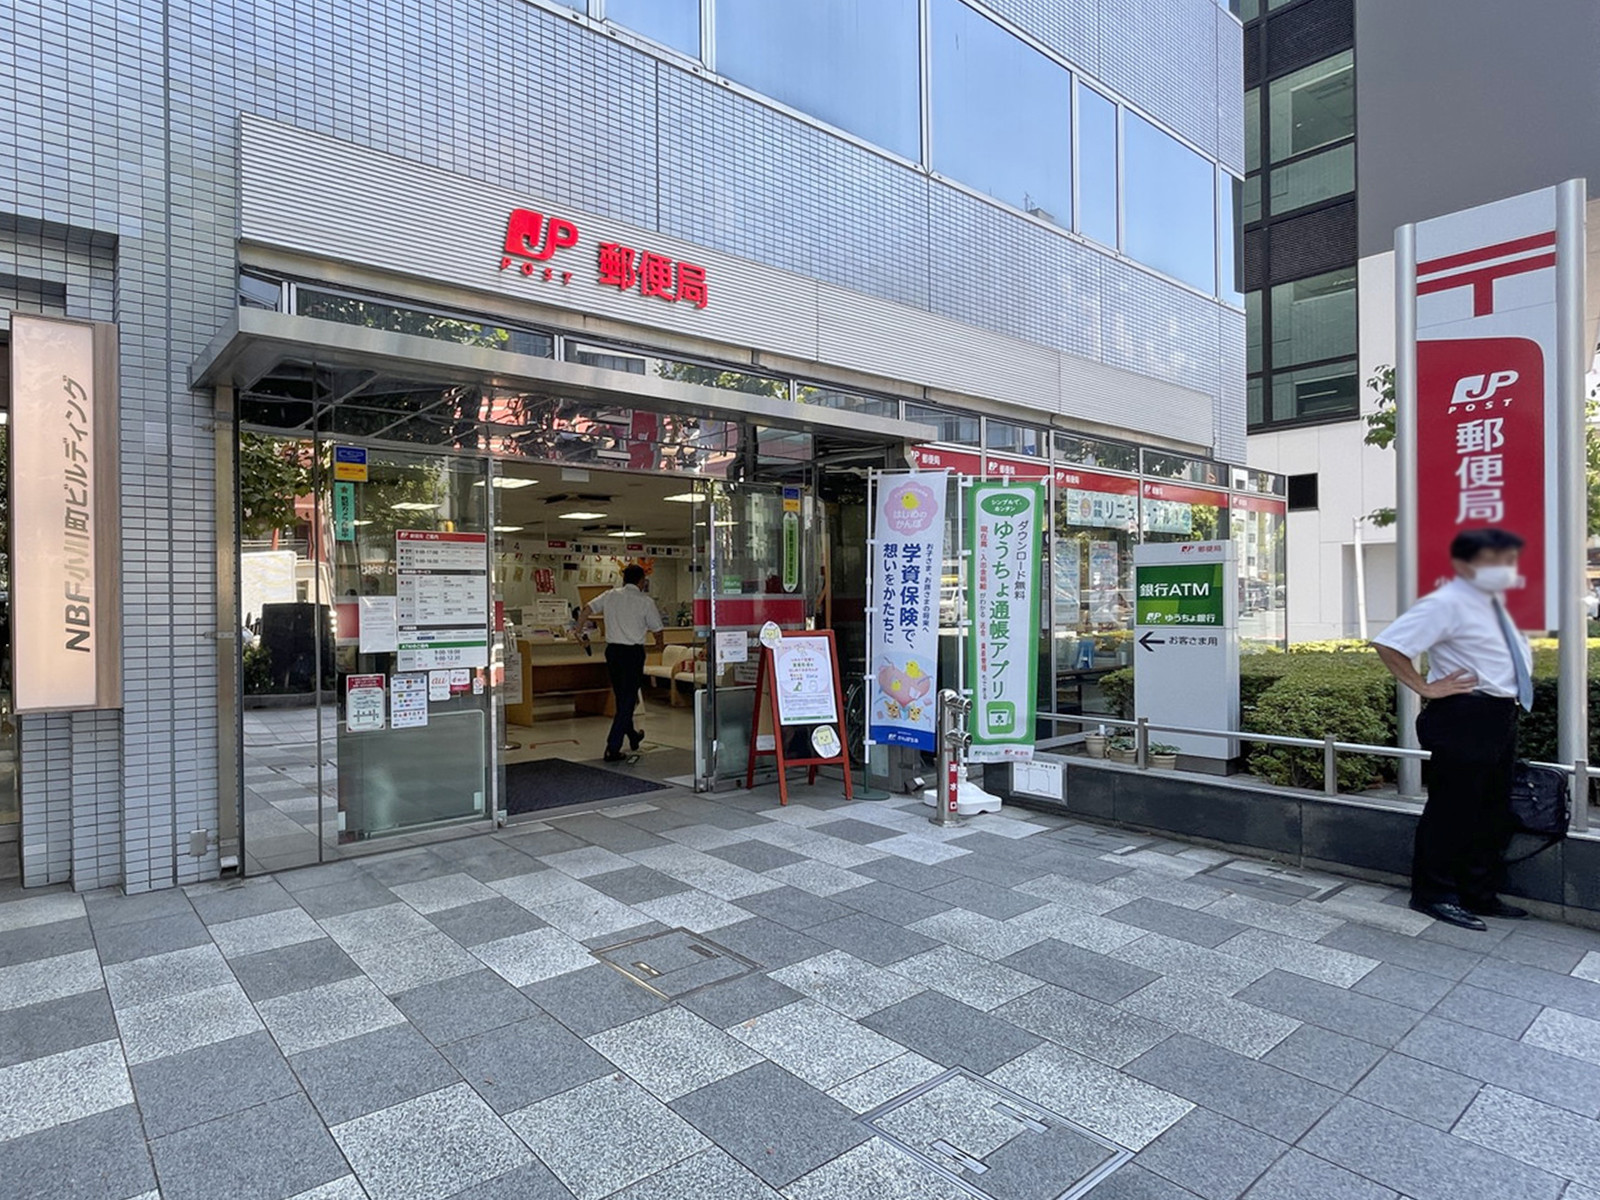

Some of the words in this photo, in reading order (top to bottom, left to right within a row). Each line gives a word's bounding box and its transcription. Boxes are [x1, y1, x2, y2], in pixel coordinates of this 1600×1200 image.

[504, 207, 579, 261] JP
[499, 256, 573, 286] POST
[598, 241, 709, 310] 郵便局
[1450, 369, 1520, 405] JP
[1447, 397, 1514, 415] POST
[921, 453, 941, 466] 郵便局
[999, 464, 1016, 476] 郵便局
[1454, 416, 1505, 525] 郵便局
[63, 375, 90, 652] NBF小川町ビルディング
[892, 509, 928, 521] はじめの
[895, 518, 923, 530] かんぽ
[1014, 520, 1029, 601] ダウンロード無料
[1197, 545, 1222, 553] 郵便局
[882, 543, 898, 645] 想いをかたちに
[899, 543, 922, 650] 学資保険で、
[1139, 582, 1210, 598] 銀行ATM
[989, 520, 1014, 700] ゆうちょ通帳アプリ
[1164, 612, 1216, 624] ゆうちょ銀行
[1168, 635, 1218, 647] お客さま用
